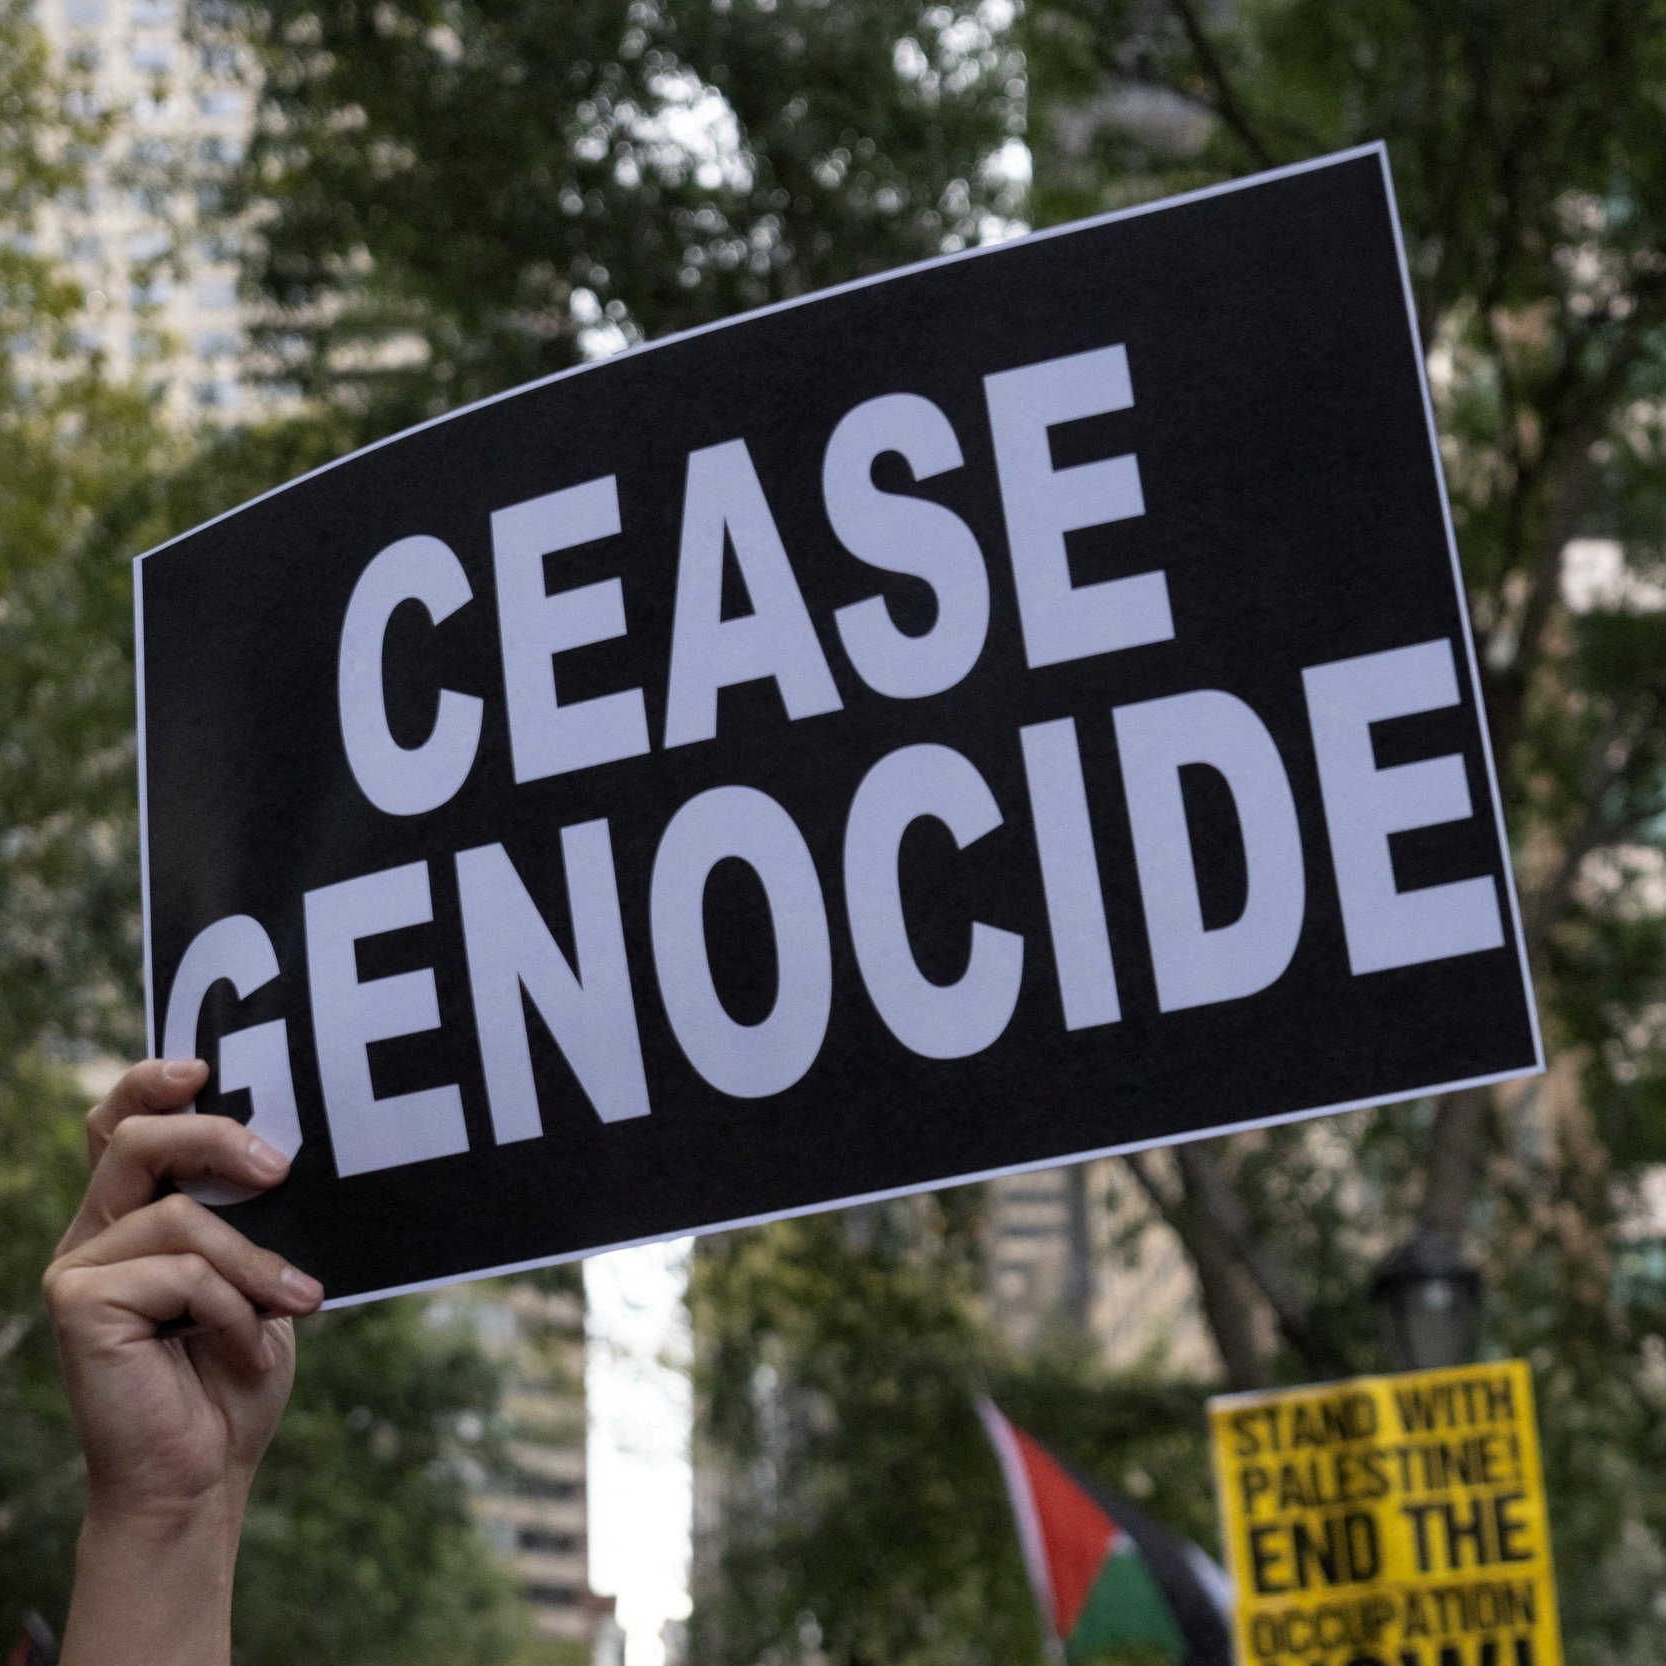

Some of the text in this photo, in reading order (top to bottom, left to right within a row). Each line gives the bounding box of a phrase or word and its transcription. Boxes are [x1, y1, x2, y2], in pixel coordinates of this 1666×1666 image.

[338, 343, 1176, 817] CEASE
[162, 637, 1506, 1206] GENOCIDE
[1231, 1376, 1516, 1455] STAND WITH
[1241, 1433, 1523, 1515] PALESTINE!
[1250, 1494, 1535, 1595] END THE
[1250, 1581, 1537, 1659] OCCUPATION
